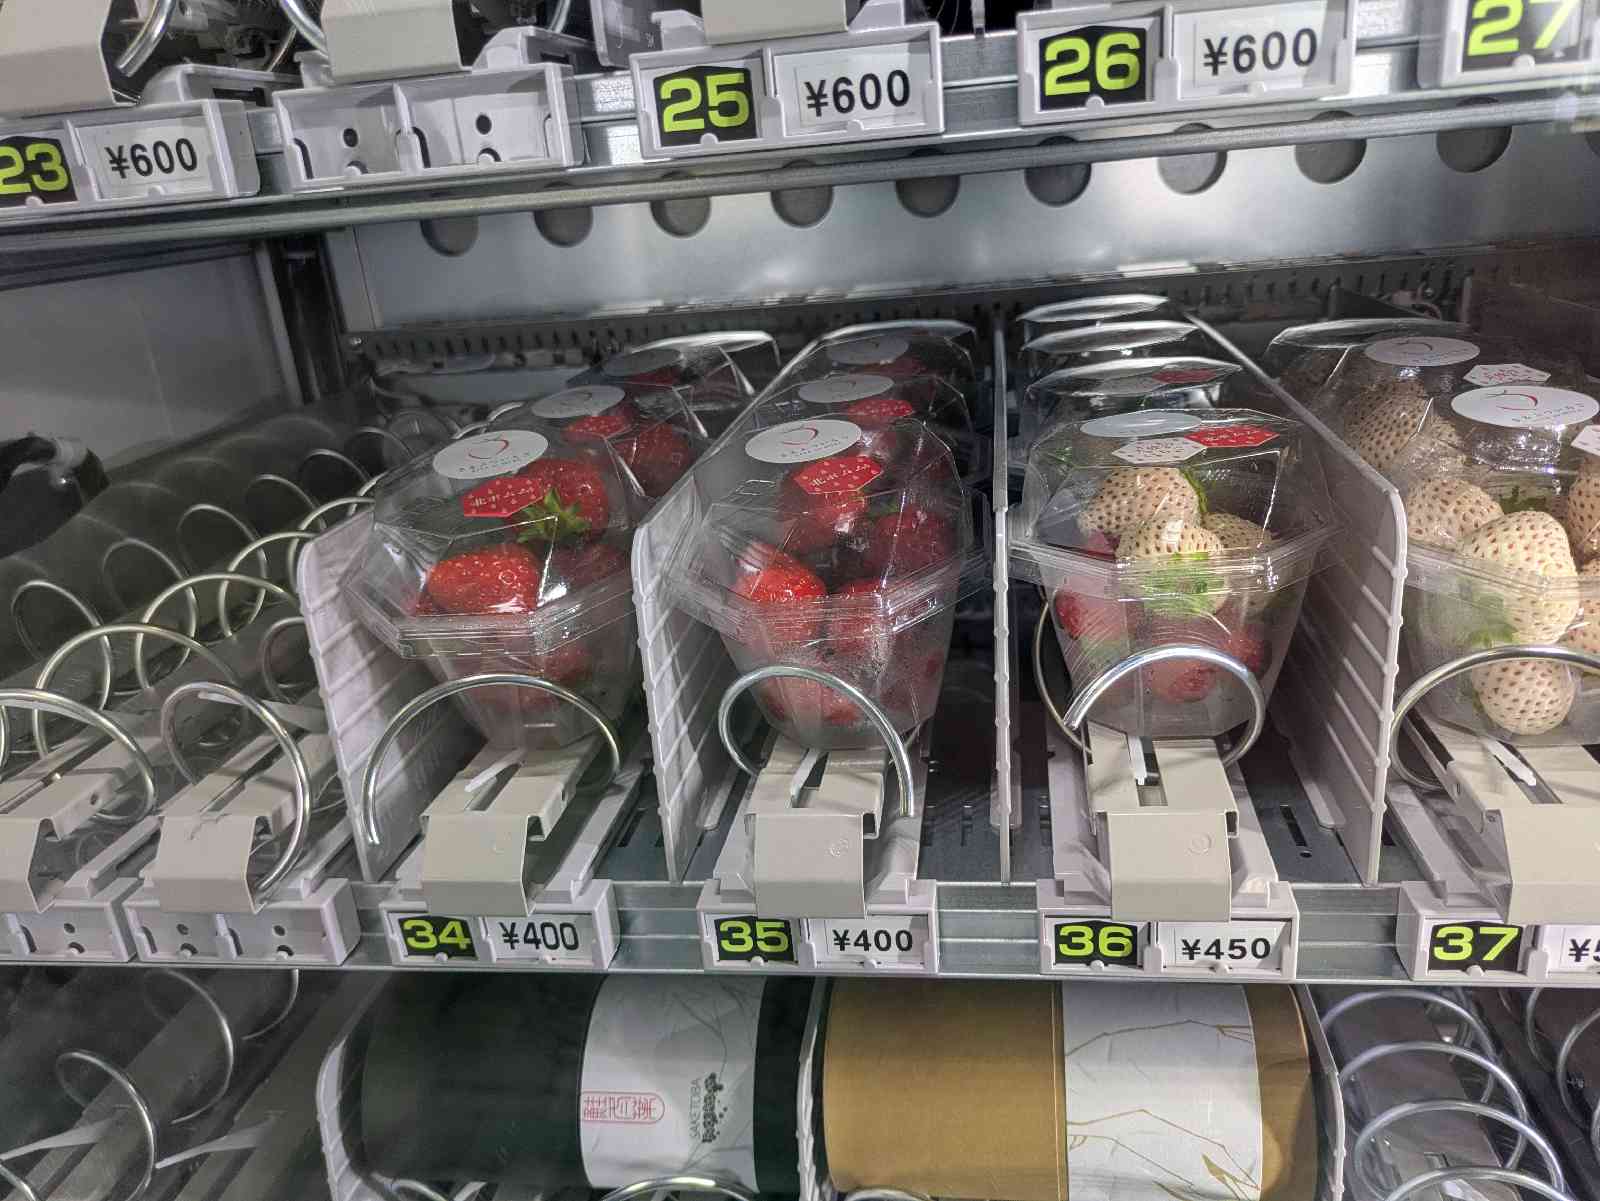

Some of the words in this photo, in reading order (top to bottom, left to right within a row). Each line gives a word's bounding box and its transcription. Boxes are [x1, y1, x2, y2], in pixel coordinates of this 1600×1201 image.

[1467, 0, 1580, 56] 27
[1044, 31, 1142, 96] 26
[1203, 27, 1318, 76] ¥600
[660, 72, 750, 133] 25
[804, 69, 911, 117] ¥600
[0, 143, 69, 195] 23
[105, 138, 199, 179] ¥600
[402, 919, 472, 950] 34
[499, 921, 580, 950] ¥400
[719, 920, 790, 953] 35
[832, 929, 914, 952] ¥400
[1058, 925, 1134, 957] 36
[1181, 937, 1272, 961] ¥450
[1433, 926, 1519, 961] 37
